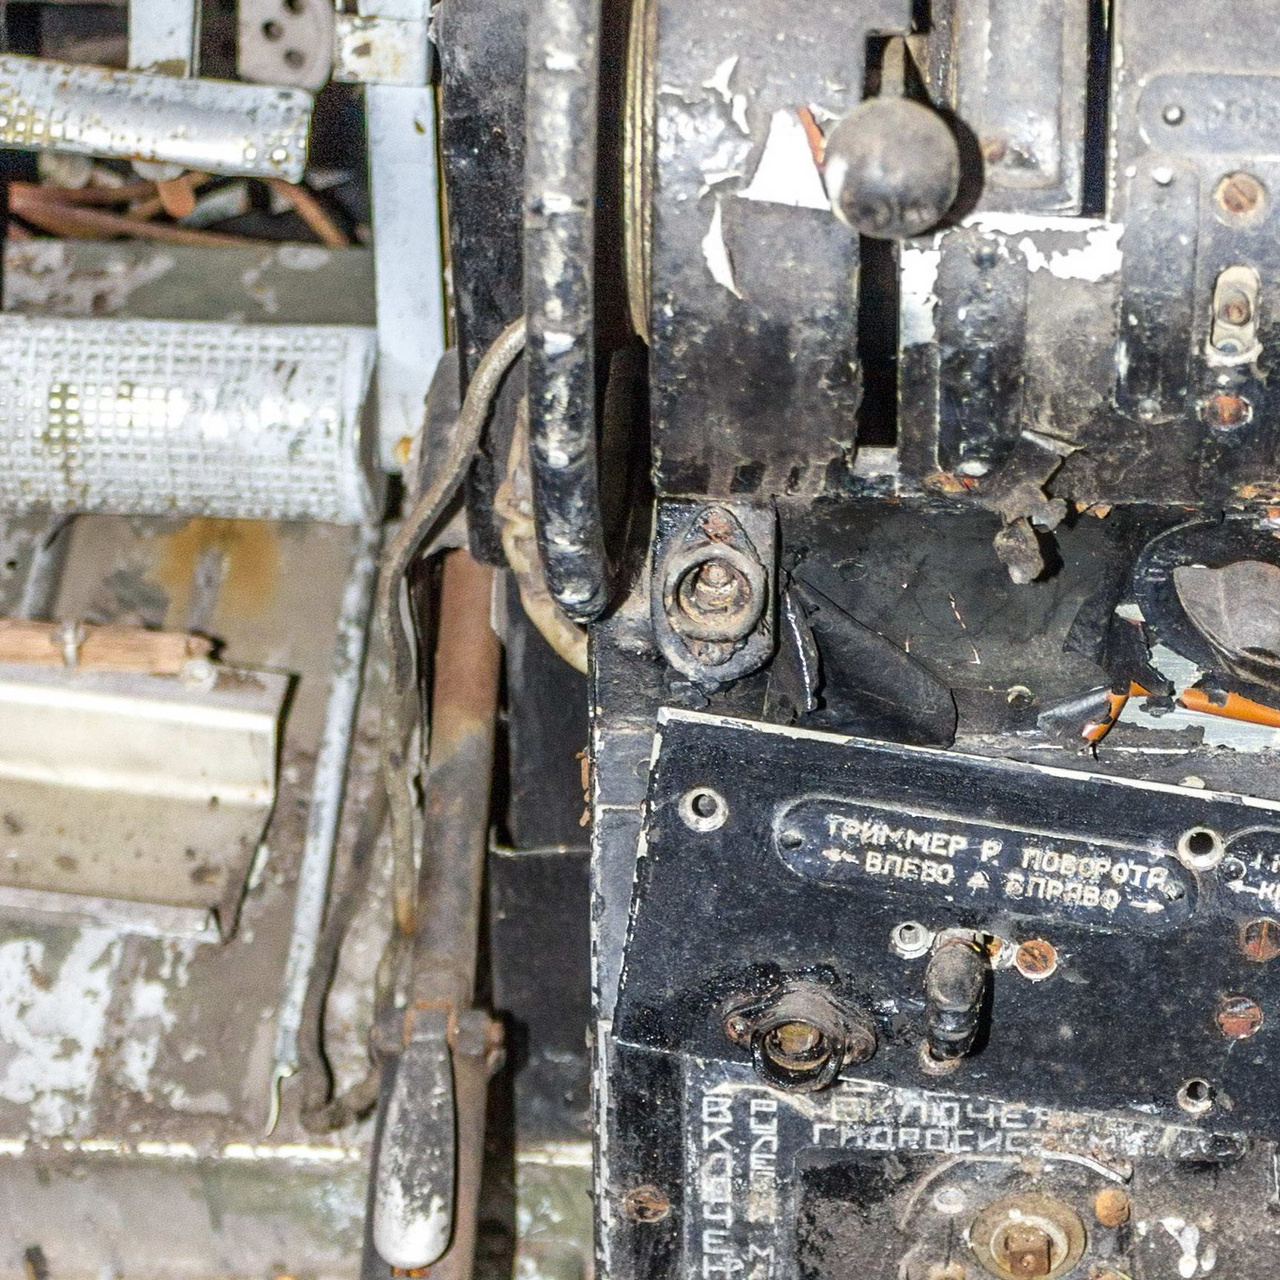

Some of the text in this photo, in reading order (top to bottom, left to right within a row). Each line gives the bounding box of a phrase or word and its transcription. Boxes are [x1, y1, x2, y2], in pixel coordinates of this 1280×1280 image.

[825, 814, 969, 858] ТРИММЕР
[1020, 846, 1170, 891] ПОВОРОТА
[864, 850, 1122, 910] ВЛЕВО ВПРАВО
